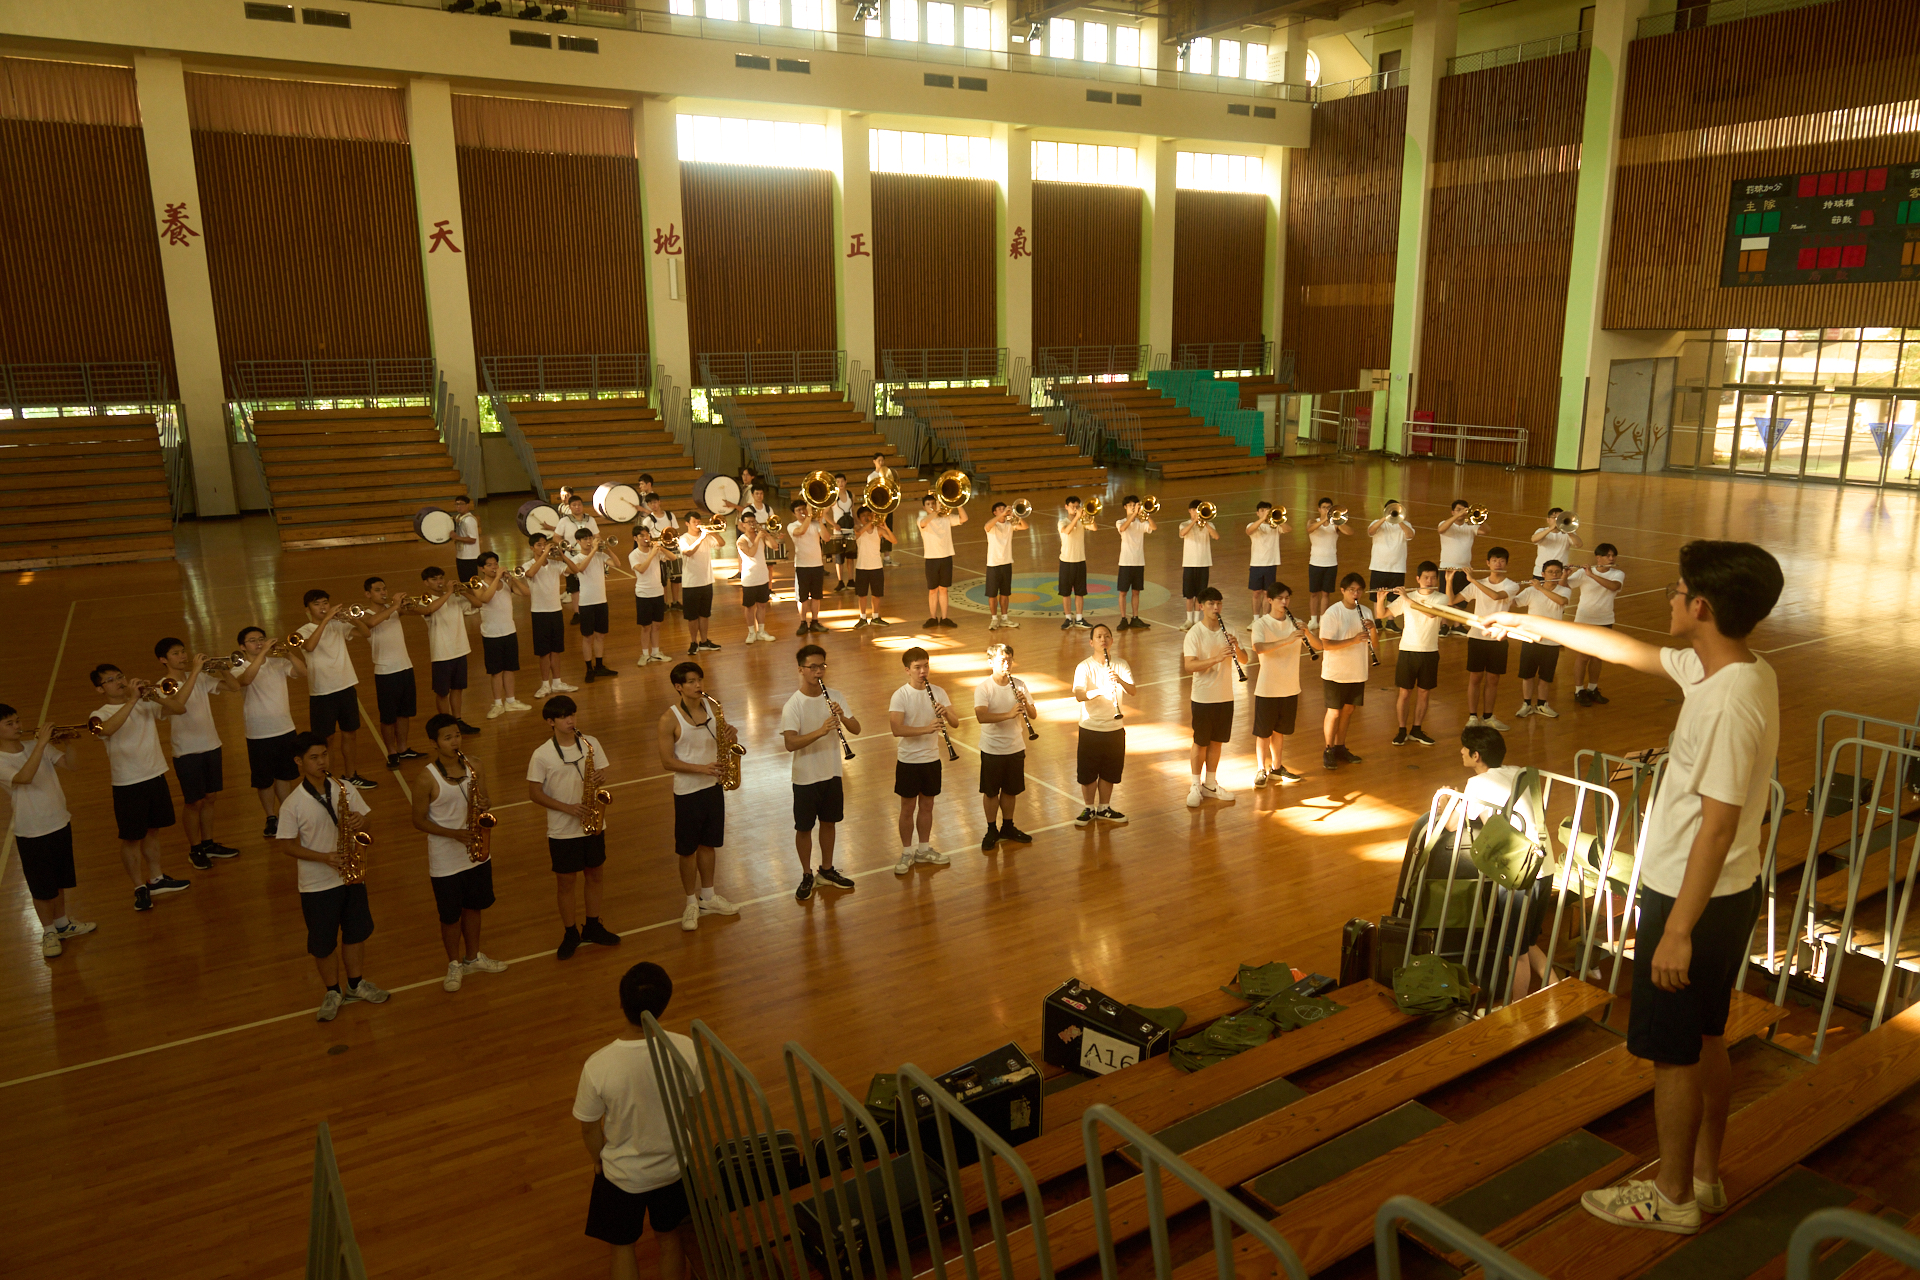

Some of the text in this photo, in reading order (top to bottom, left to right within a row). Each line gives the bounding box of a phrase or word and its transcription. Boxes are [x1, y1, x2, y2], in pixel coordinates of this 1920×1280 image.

[1743, 199, 1777, 212] 主隊
[161, 202, 1032, 259] 養 天 地 正 氣
[1084, 1043, 1135, 1069] A16
